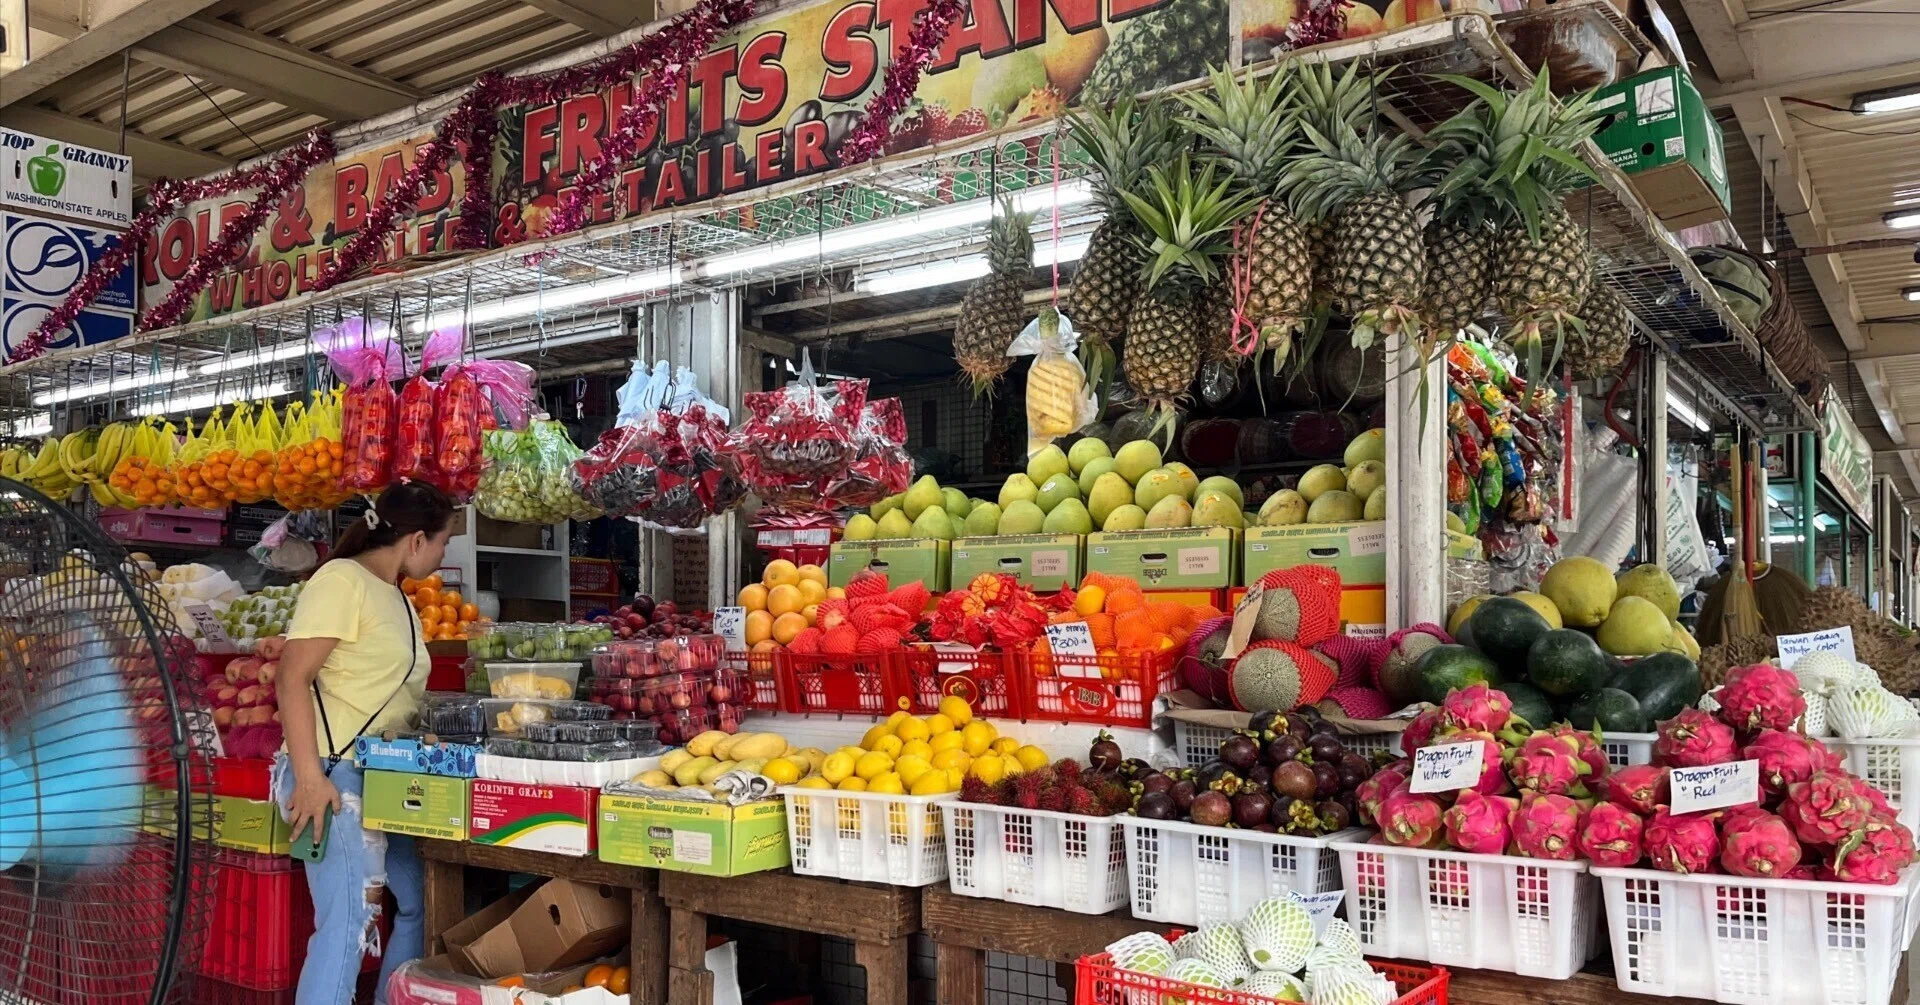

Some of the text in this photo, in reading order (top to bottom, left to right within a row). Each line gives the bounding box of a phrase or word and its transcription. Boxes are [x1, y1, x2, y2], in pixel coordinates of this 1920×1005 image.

[819, 0, 1172, 100] STAN
[2, 132, 129, 172] TOP GRANNY
[6, 190, 127, 222] WASHINGTON STATE APPLES
[270, 184, 315, 252] &
[495, 201, 527, 246] &
[370, 743, 413, 761] Blueberry
[1417, 744, 1474, 765] Dragon Fruit
[1673, 763, 1740, 783] Dragon Fruit
[474, 783, 515, 796] KORINTH
